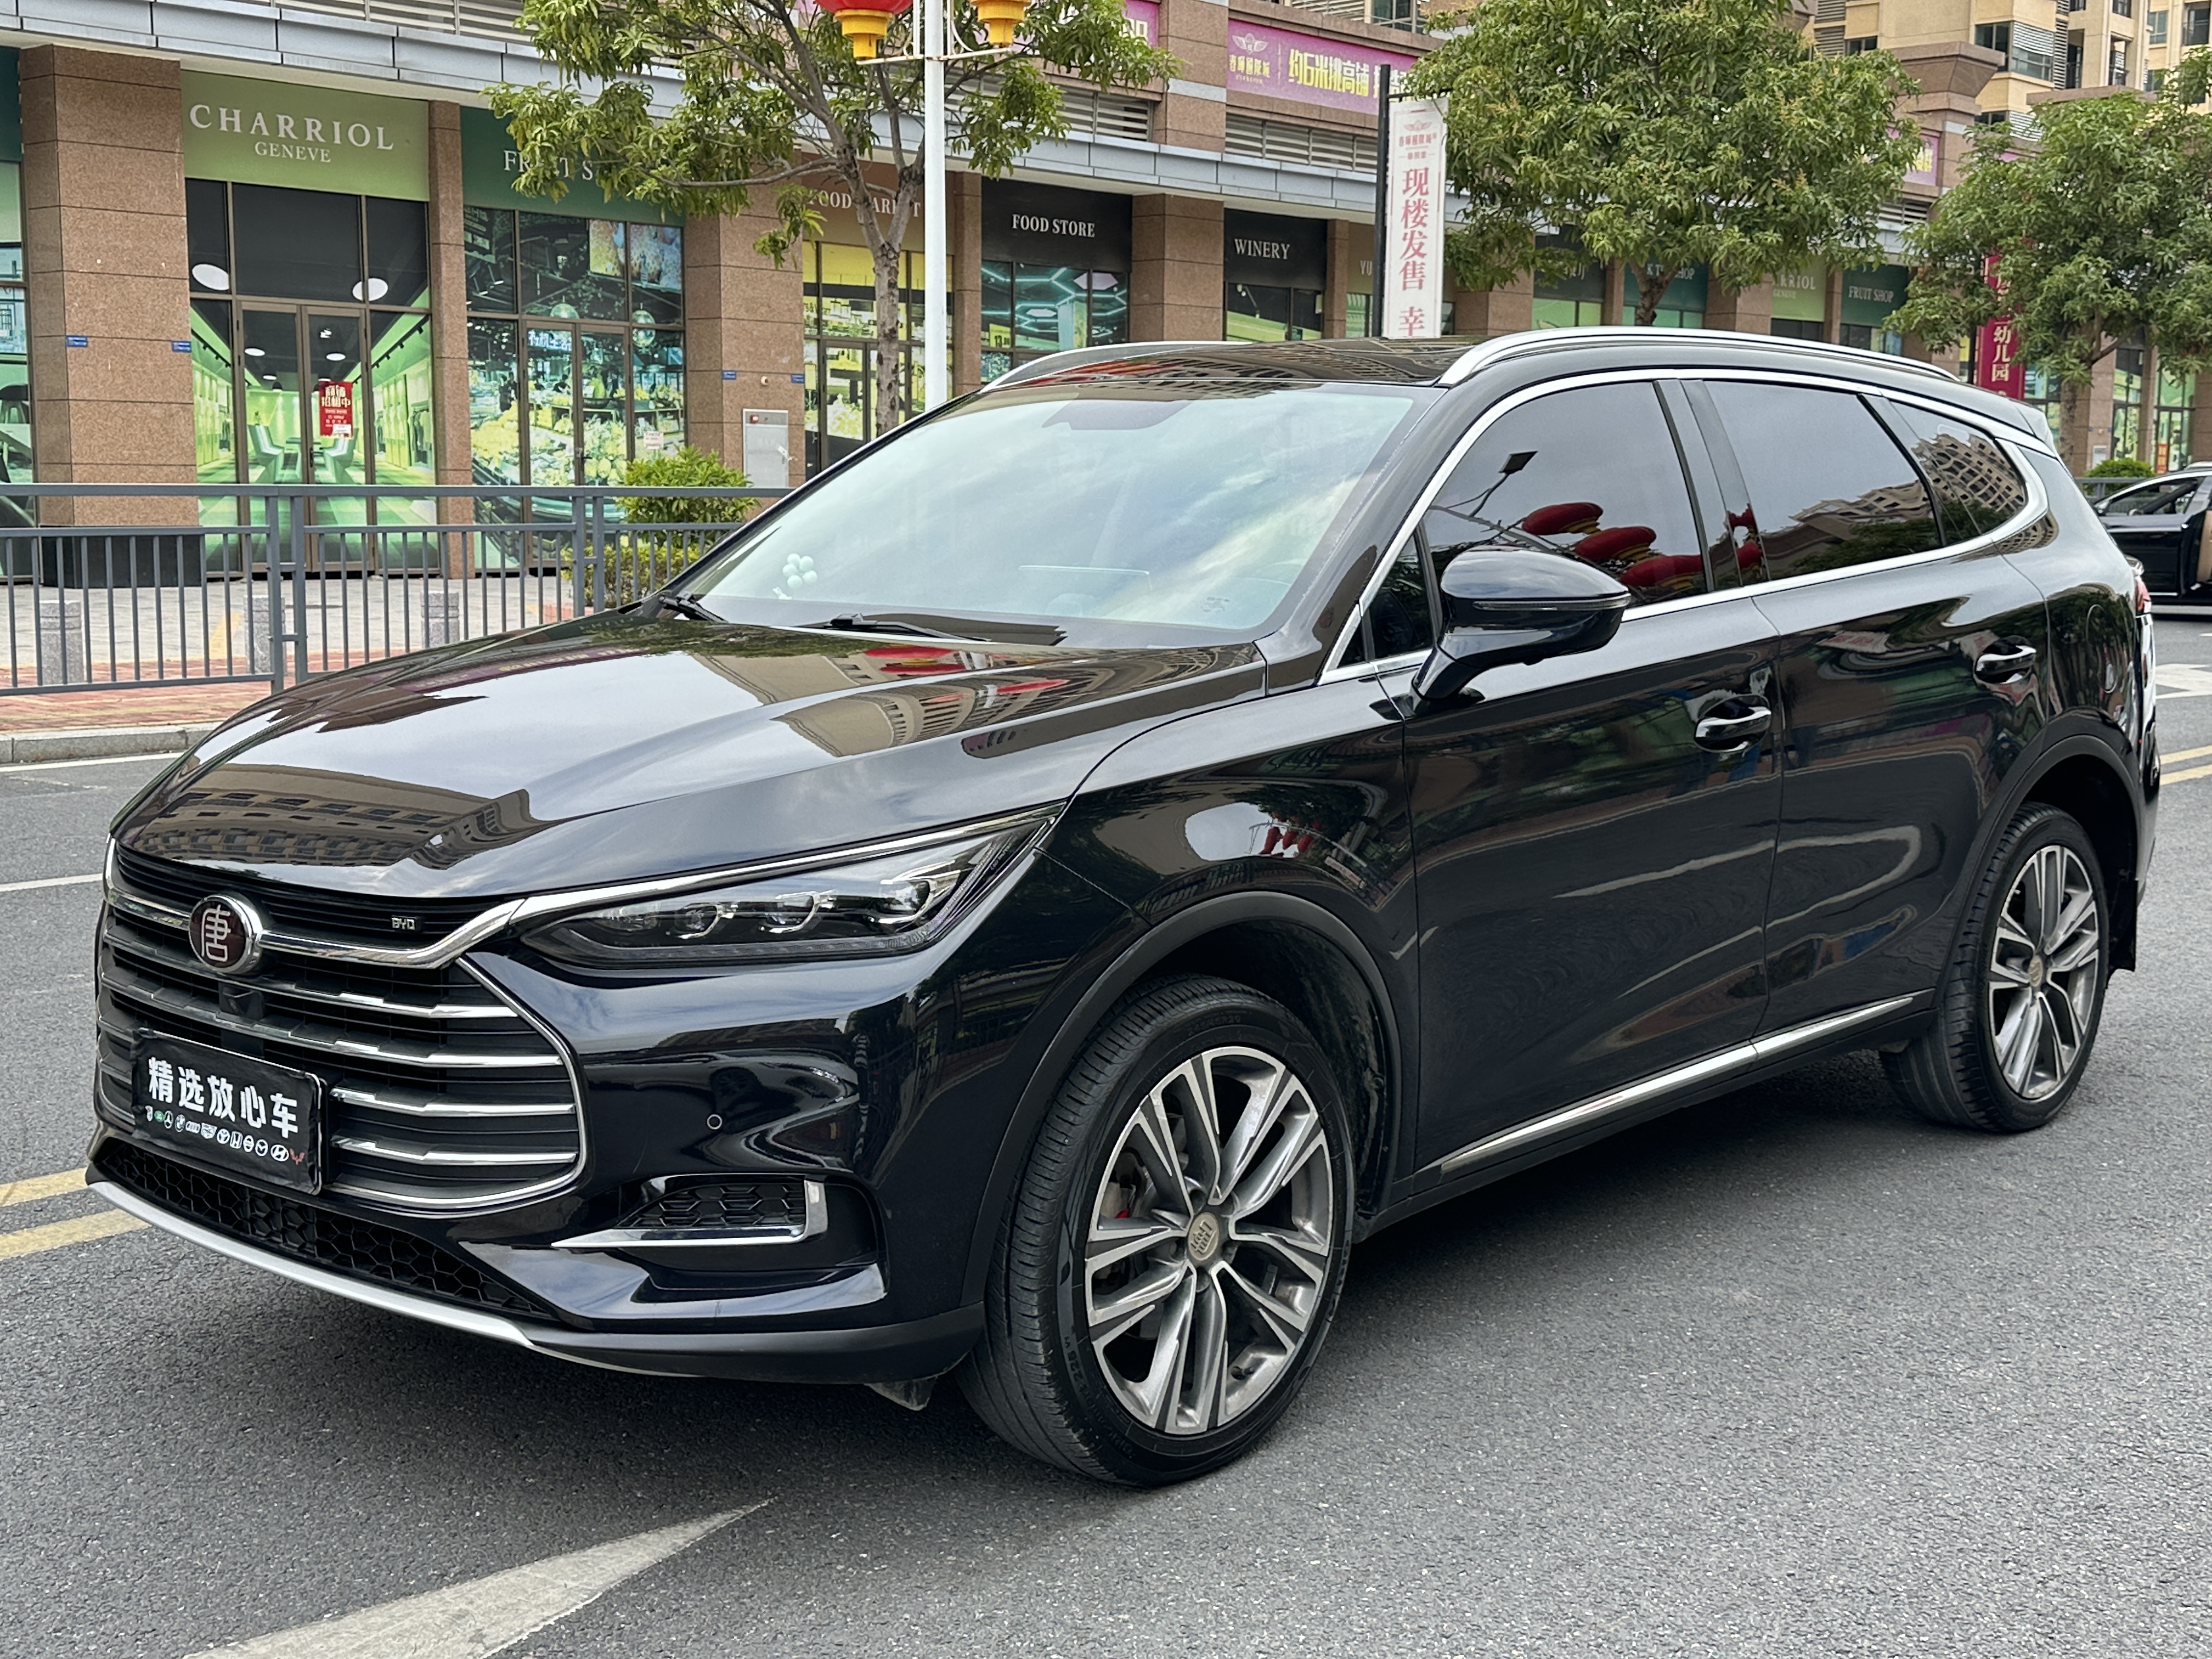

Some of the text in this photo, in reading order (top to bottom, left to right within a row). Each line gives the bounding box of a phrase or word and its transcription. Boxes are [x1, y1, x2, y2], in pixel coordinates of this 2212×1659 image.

[189, 104, 394, 150] CHARRIOL
[255, 142, 331, 163] GENEVE
[504, 150, 572, 178] FRT
[1012, 213, 1095, 238] FOOD STORE
[1399, 167, 1430, 291] 现楼发售
[1234, 238, 1290, 259] WINERY
[1848, 286, 1894, 303] FRUIT SHOP
[1398, 306, 1425, 336] 幸
[201, 905, 231, 962] 唐
[391, 917, 415, 930] BYD
[148, 1057, 299, 1139] 精选放心车
